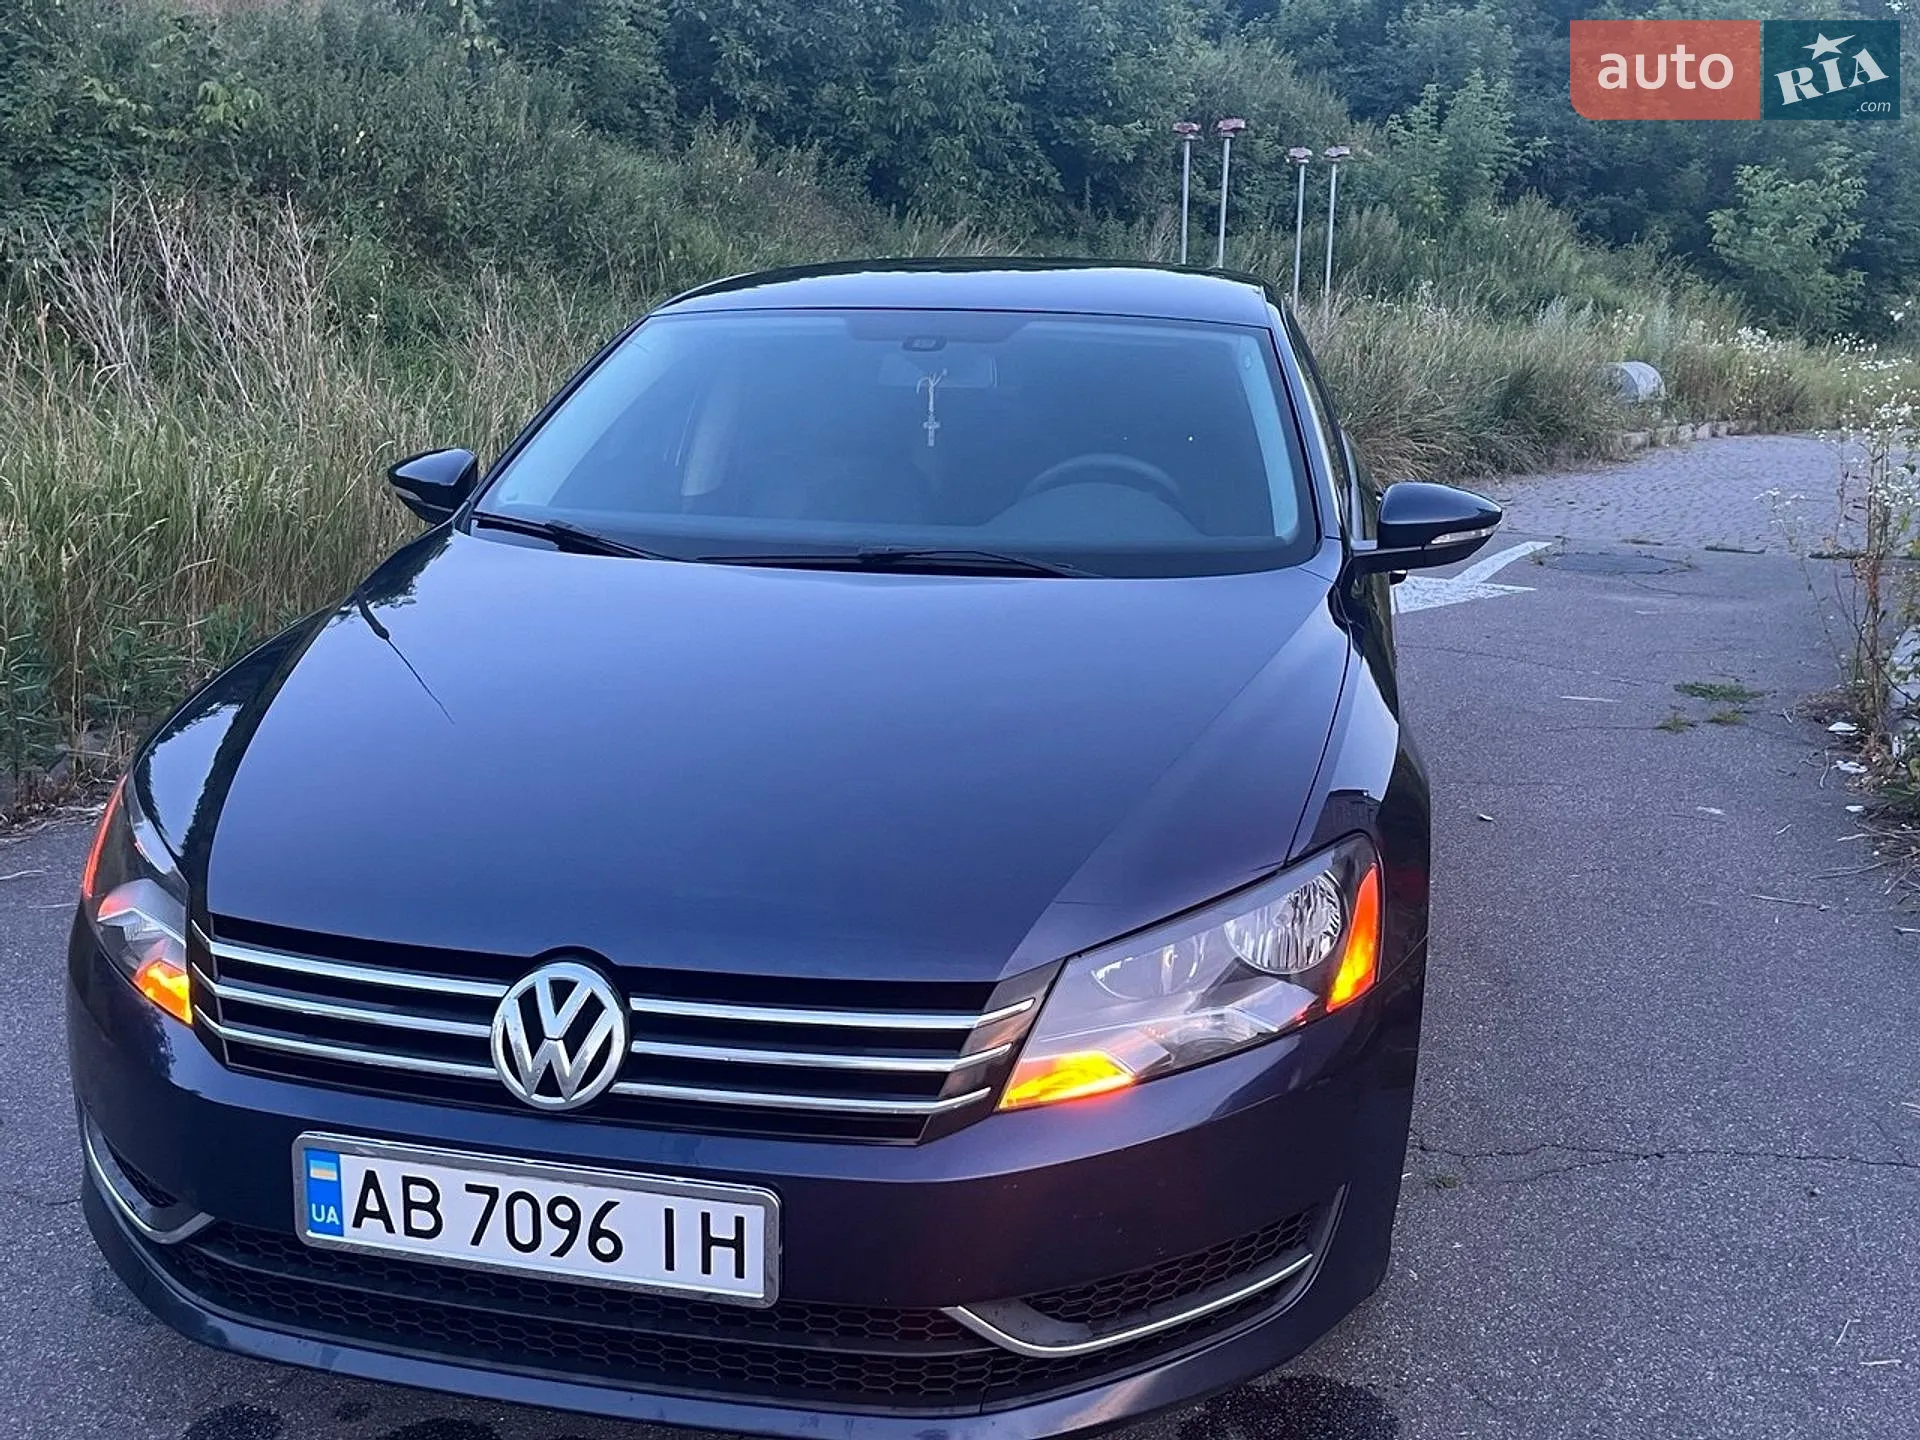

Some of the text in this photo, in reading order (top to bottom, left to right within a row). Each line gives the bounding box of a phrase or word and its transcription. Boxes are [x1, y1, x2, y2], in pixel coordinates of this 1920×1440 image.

[311, 1202, 340, 1226] UA
[351, 1168, 746, 1280] AB 7096 IH
